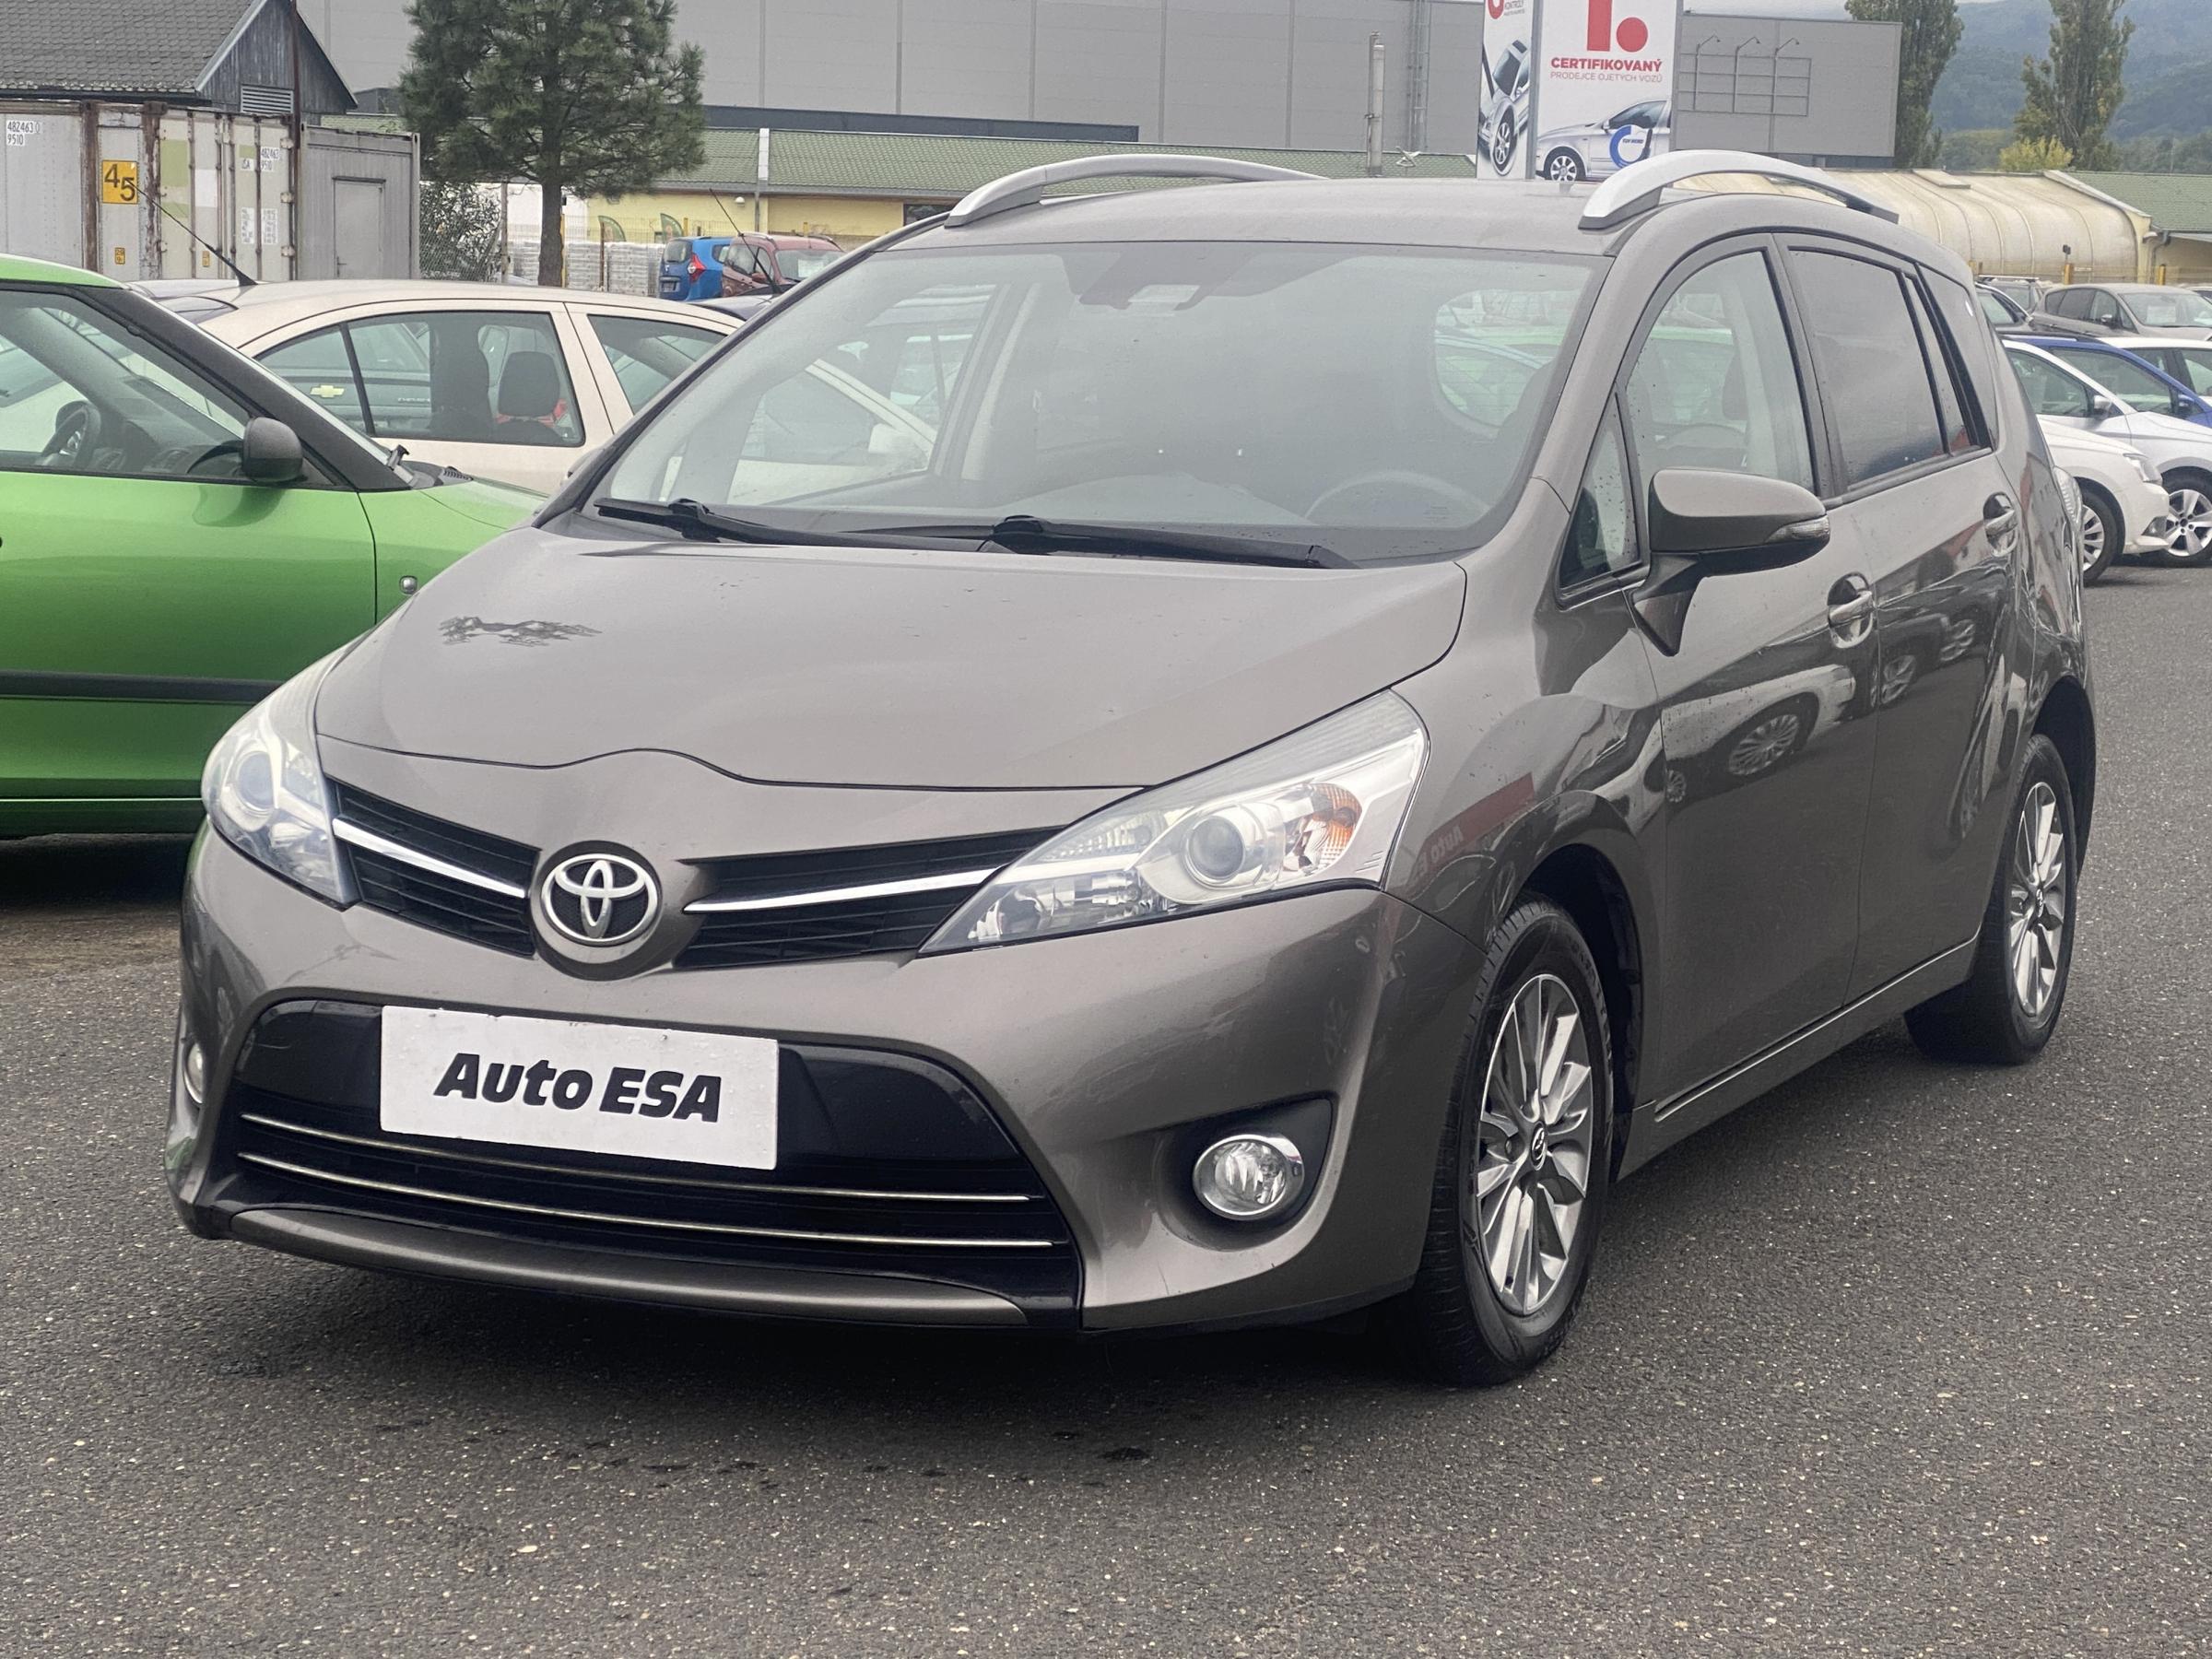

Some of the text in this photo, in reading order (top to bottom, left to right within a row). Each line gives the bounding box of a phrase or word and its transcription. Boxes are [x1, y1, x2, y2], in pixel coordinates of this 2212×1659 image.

[1550, 57, 1662, 72] CERTIFIKOVANÝ
[1550, 71, 1595, 81] PRODEJCE
[433, 1053, 723, 1123] Auto ESA
